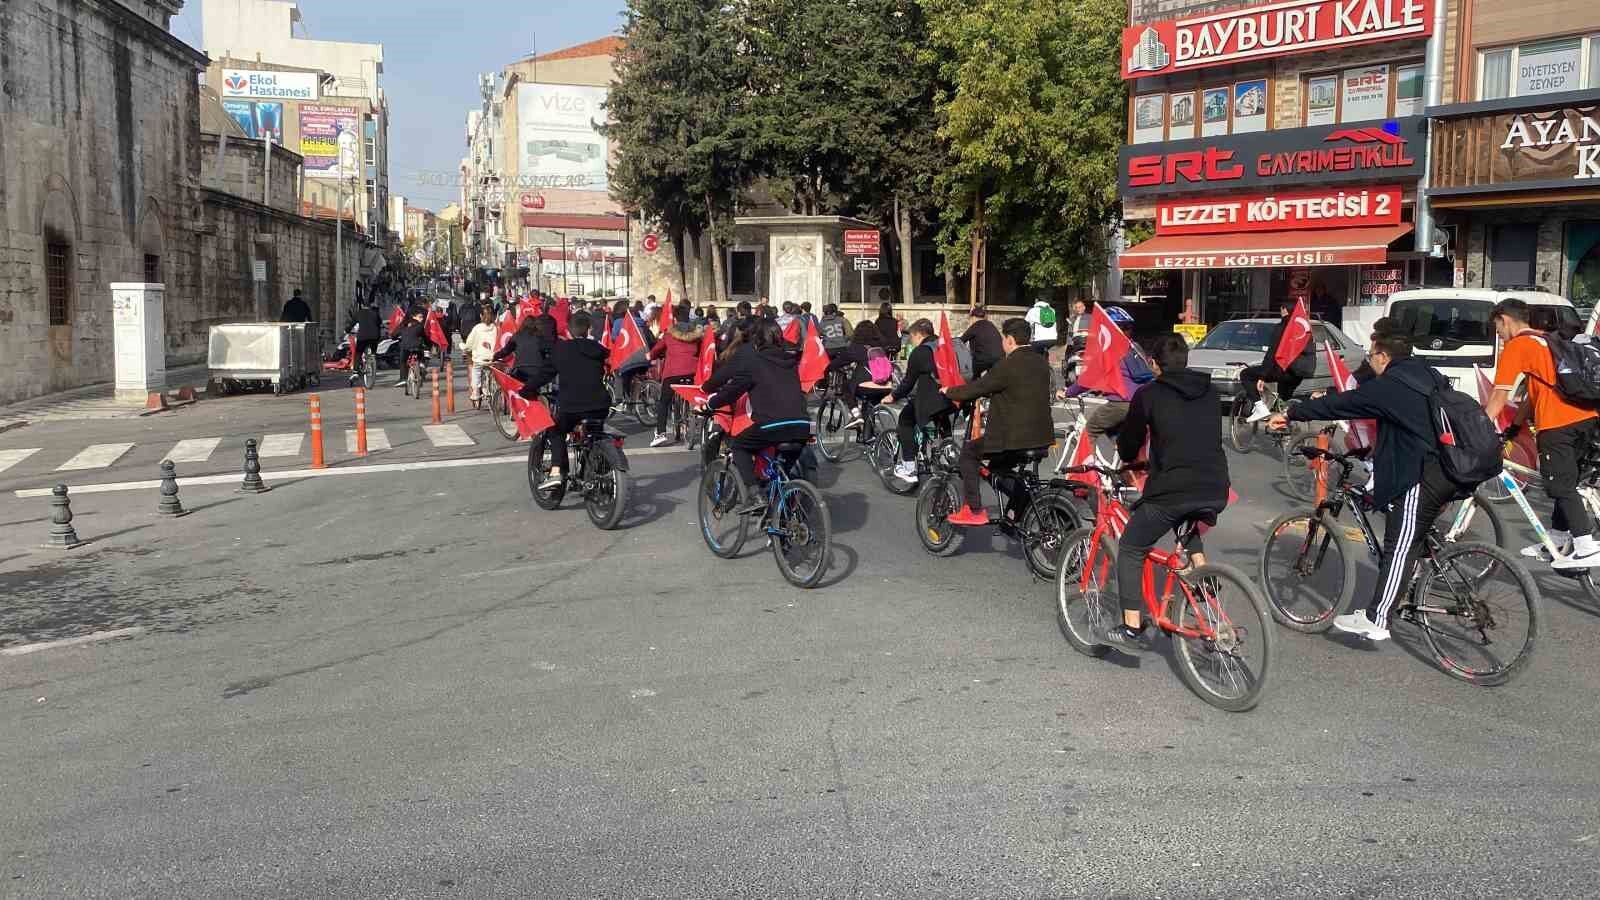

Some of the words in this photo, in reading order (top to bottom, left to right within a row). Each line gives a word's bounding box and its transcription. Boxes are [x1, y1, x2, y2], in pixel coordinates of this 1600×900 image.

[1175, 6, 1320, 60] BAYBURT
[1334, 0, 1424, 36] KALE
[249, 74, 277, 85] Ekol
[1530, 76, 1565, 90] ZEYNEP
[249, 85, 311, 97] Hastanesi
[1161, 203, 1241, 227] LEZZET
[1247, 190, 1368, 221] KÖFTECİSİ
[1374, 193, 1391, 215] 2
[1155, 256, 1217, 268] LEZZET
[1225, 252, 1321, 266] KÖFTECİSİ
[825, 323, 843, 338] 25
